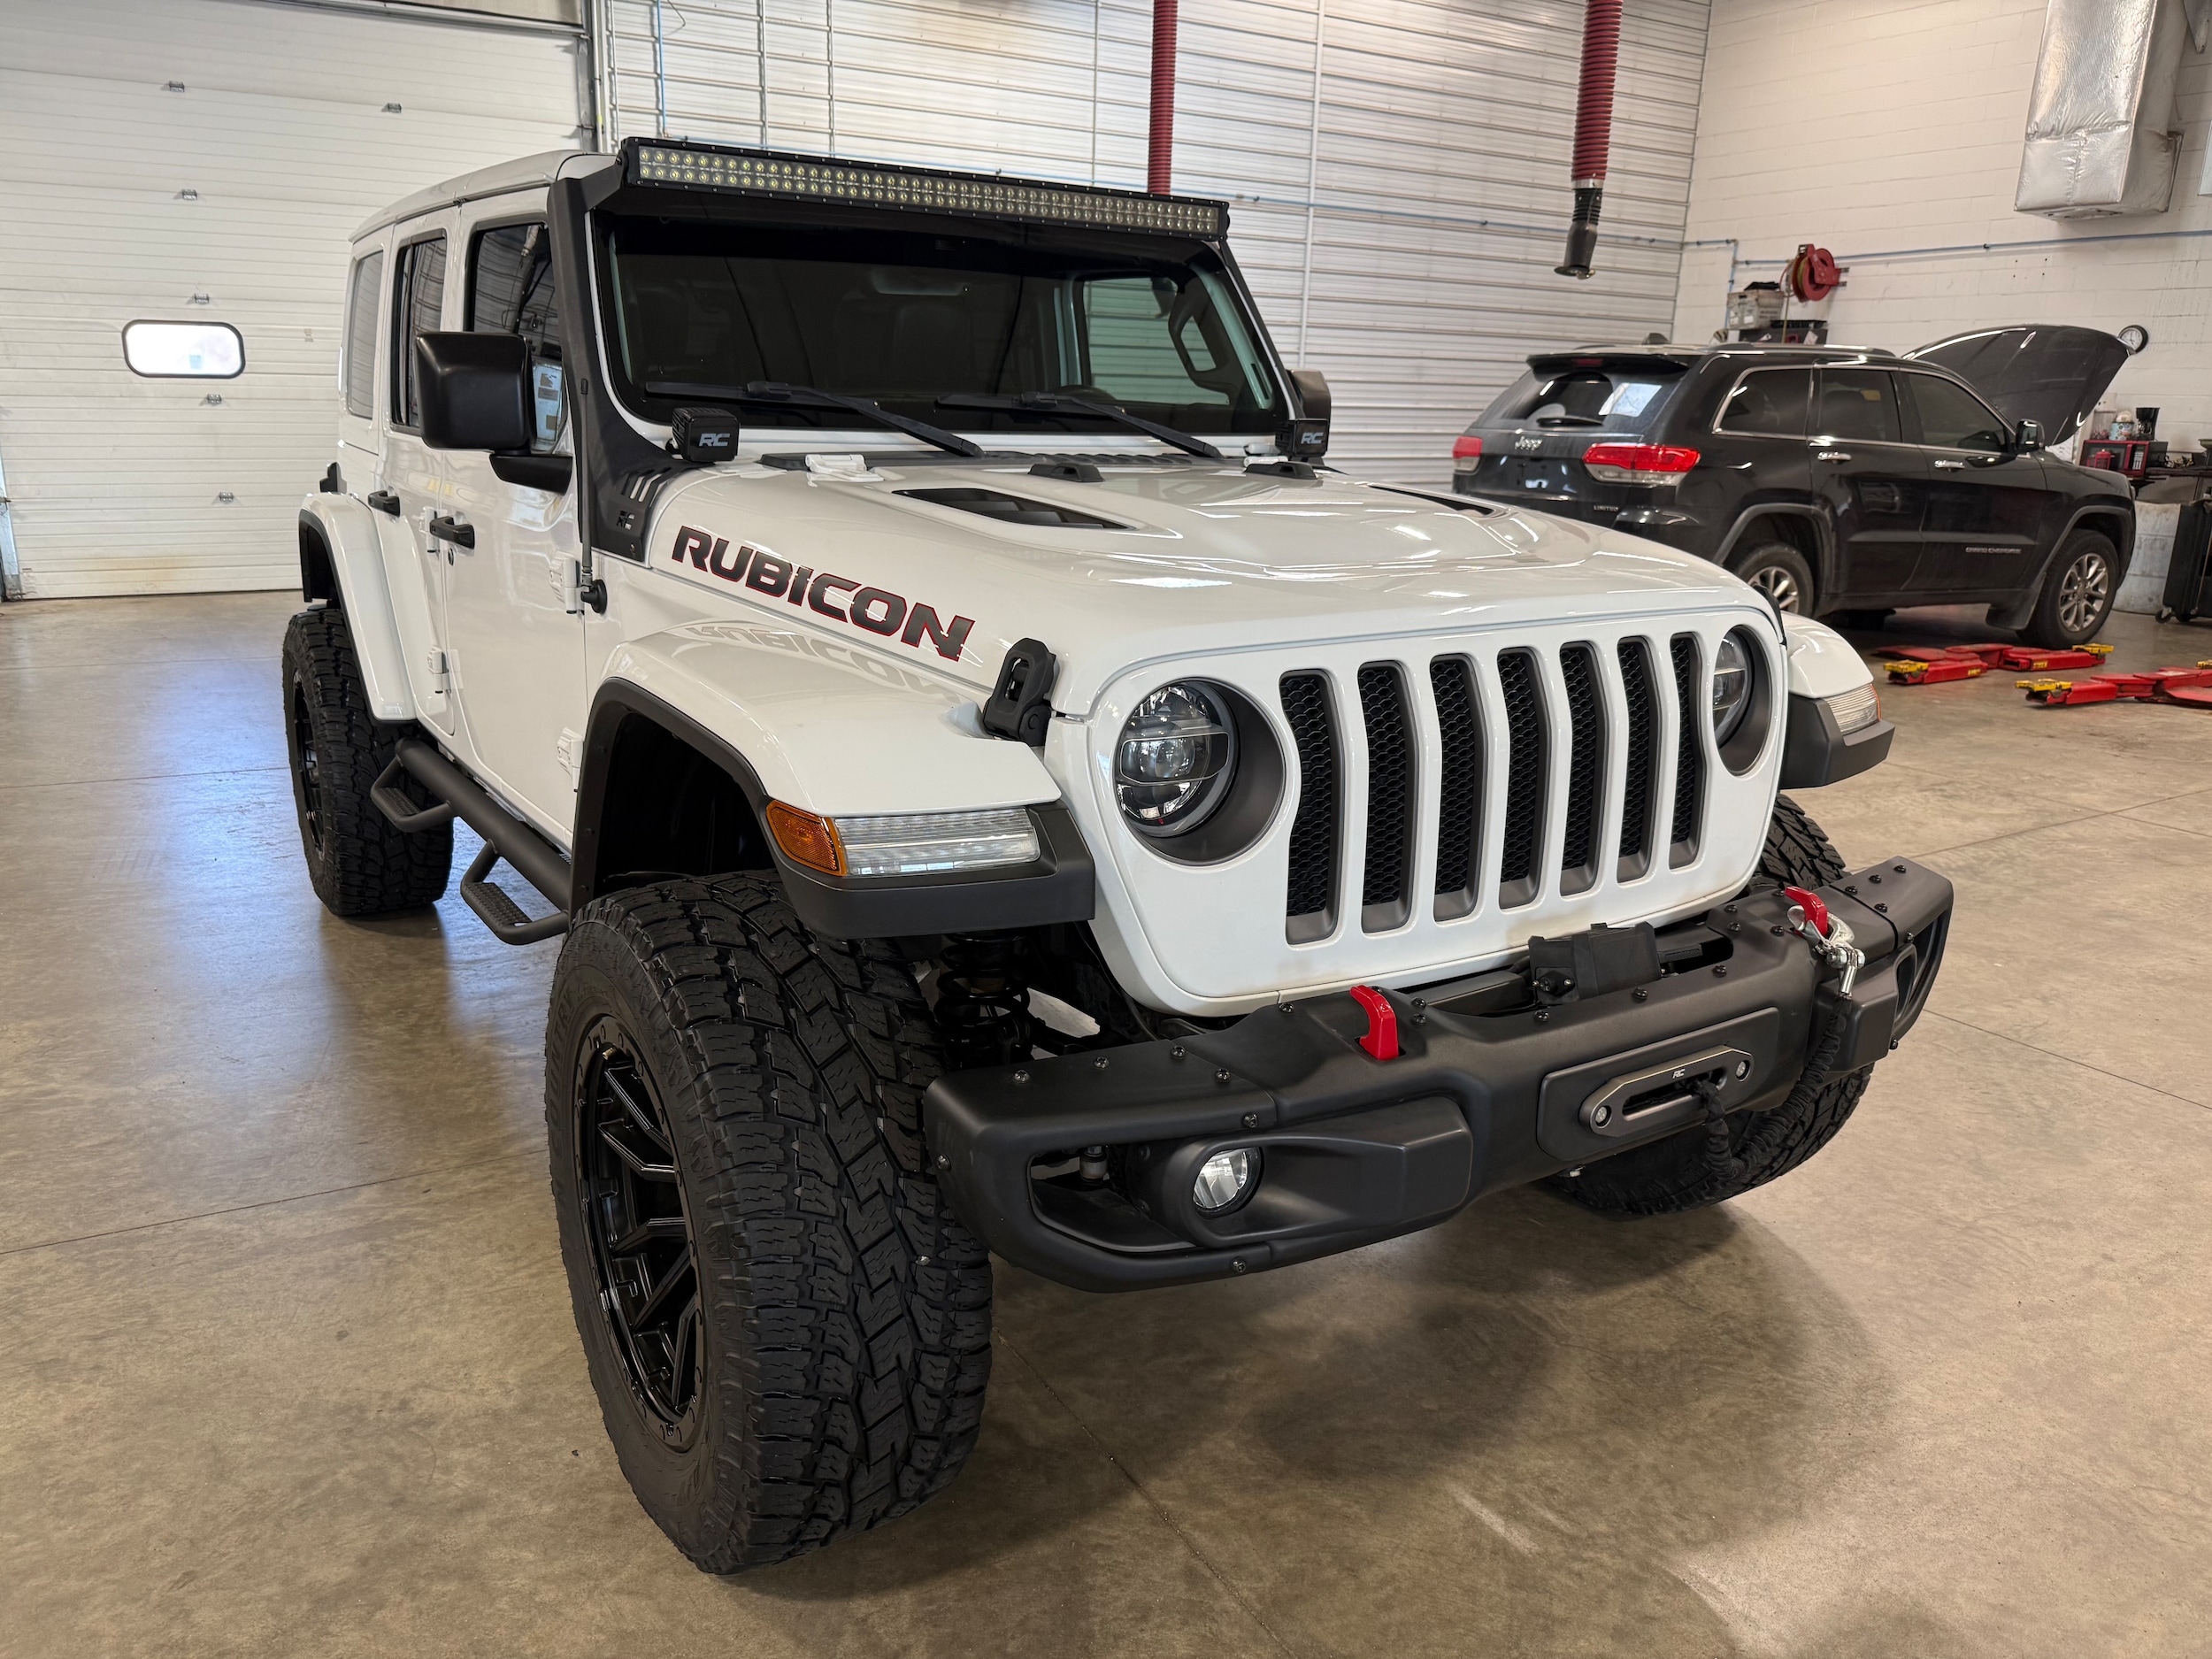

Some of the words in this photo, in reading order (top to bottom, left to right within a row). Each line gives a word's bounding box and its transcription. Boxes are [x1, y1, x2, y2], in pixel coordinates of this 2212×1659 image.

[699, 433, 731, 447] RC
[1301, 432, 1325, 444] RC
[1514, 436, 1542, 452] Jeep
[671, 525, 976, 662] RUBICON
[1672, 1068, 1686, 1079] RC
